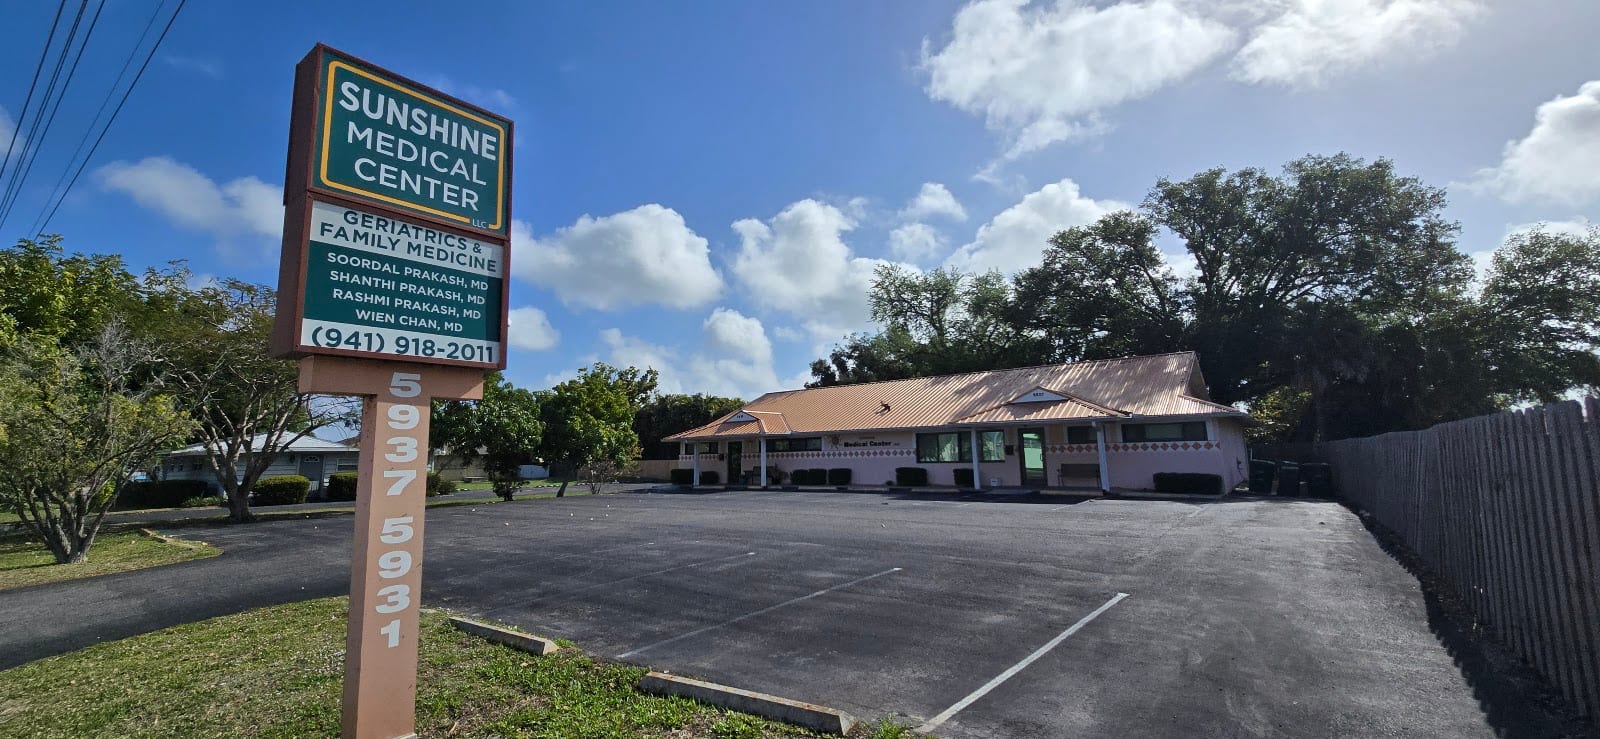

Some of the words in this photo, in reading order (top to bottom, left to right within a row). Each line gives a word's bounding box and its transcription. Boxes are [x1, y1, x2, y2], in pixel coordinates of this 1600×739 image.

[339, 81, 497, 160] SUNSHINE
[347, 122, 486, 185] MEDICAL
[354, 158, 479, 211] CENTER
[343, 211, 467, 249] GERIATRICS
[473, 243, 482, 253] &
[472, 218, 486, 229] LLC
[320, 222, 401, 250] FAMILY
[407, 242, 497, 272] MEDICINE
[327, 252, 400, 275] SOORDAL
[404, 267, 468, 289] PRAKASH,
[471, 279, 488, 290] MD
[330, 271, 395, 290] SHANTHI
[400, 283, 464, 303] PRAKASH,
[468, 294, 485, 305] MD
[333, 289, 390, 306] RASHMI
[395, 298, 459, 318] PRAKASH,
[463, 309, 481, 319] MD
[356, 309, 395, 323] WIEN
[399, 315, 440, 331] CHAN,
[445, 321, 463, 332] MD
[312, 326, 385, 352] (941)
[395, 336, 493, 362] 918-2011
[384, 372, 421, 496] 5937
[375, 516, 413, 648] 5931
